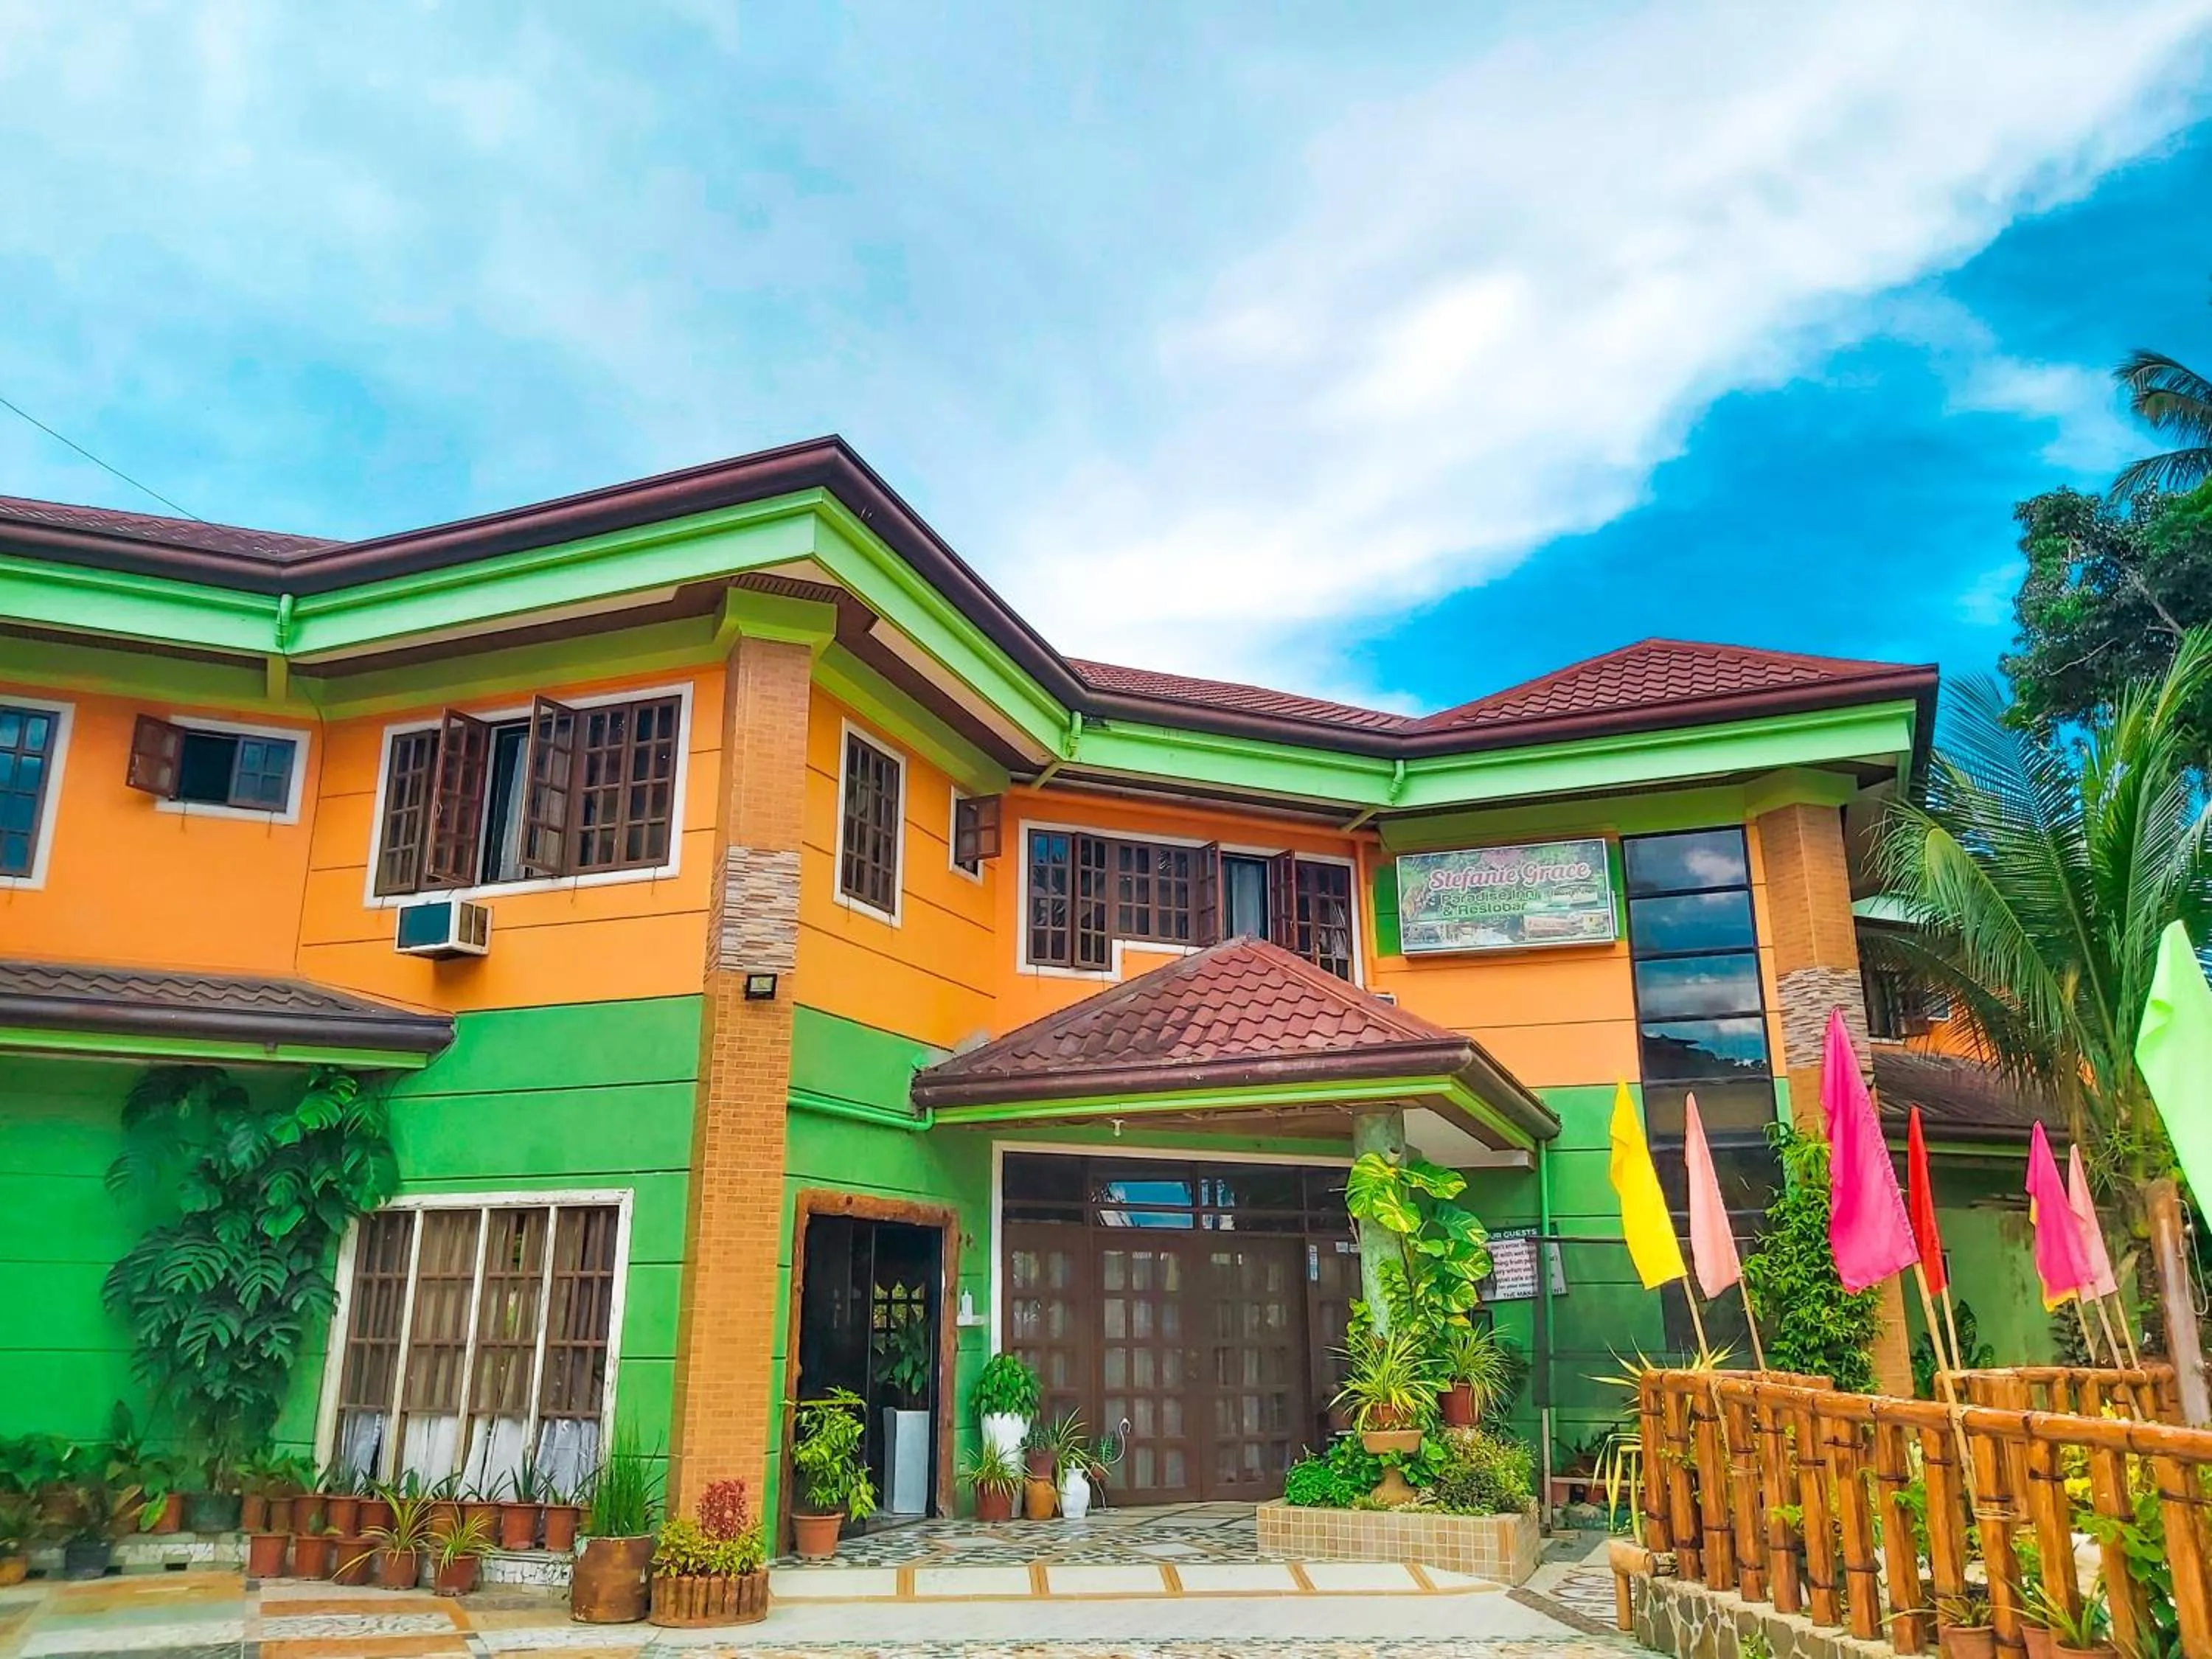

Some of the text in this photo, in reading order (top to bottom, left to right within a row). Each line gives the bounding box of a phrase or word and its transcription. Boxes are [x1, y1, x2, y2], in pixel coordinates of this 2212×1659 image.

[1430, 861, 1591, 893] Stefanie Grace
[1441, 890, 1509, 904] Paradise
[1443, 902, 1527, 916] & Restobar
[1503, 1228, 1537, 1238] GUESTS
